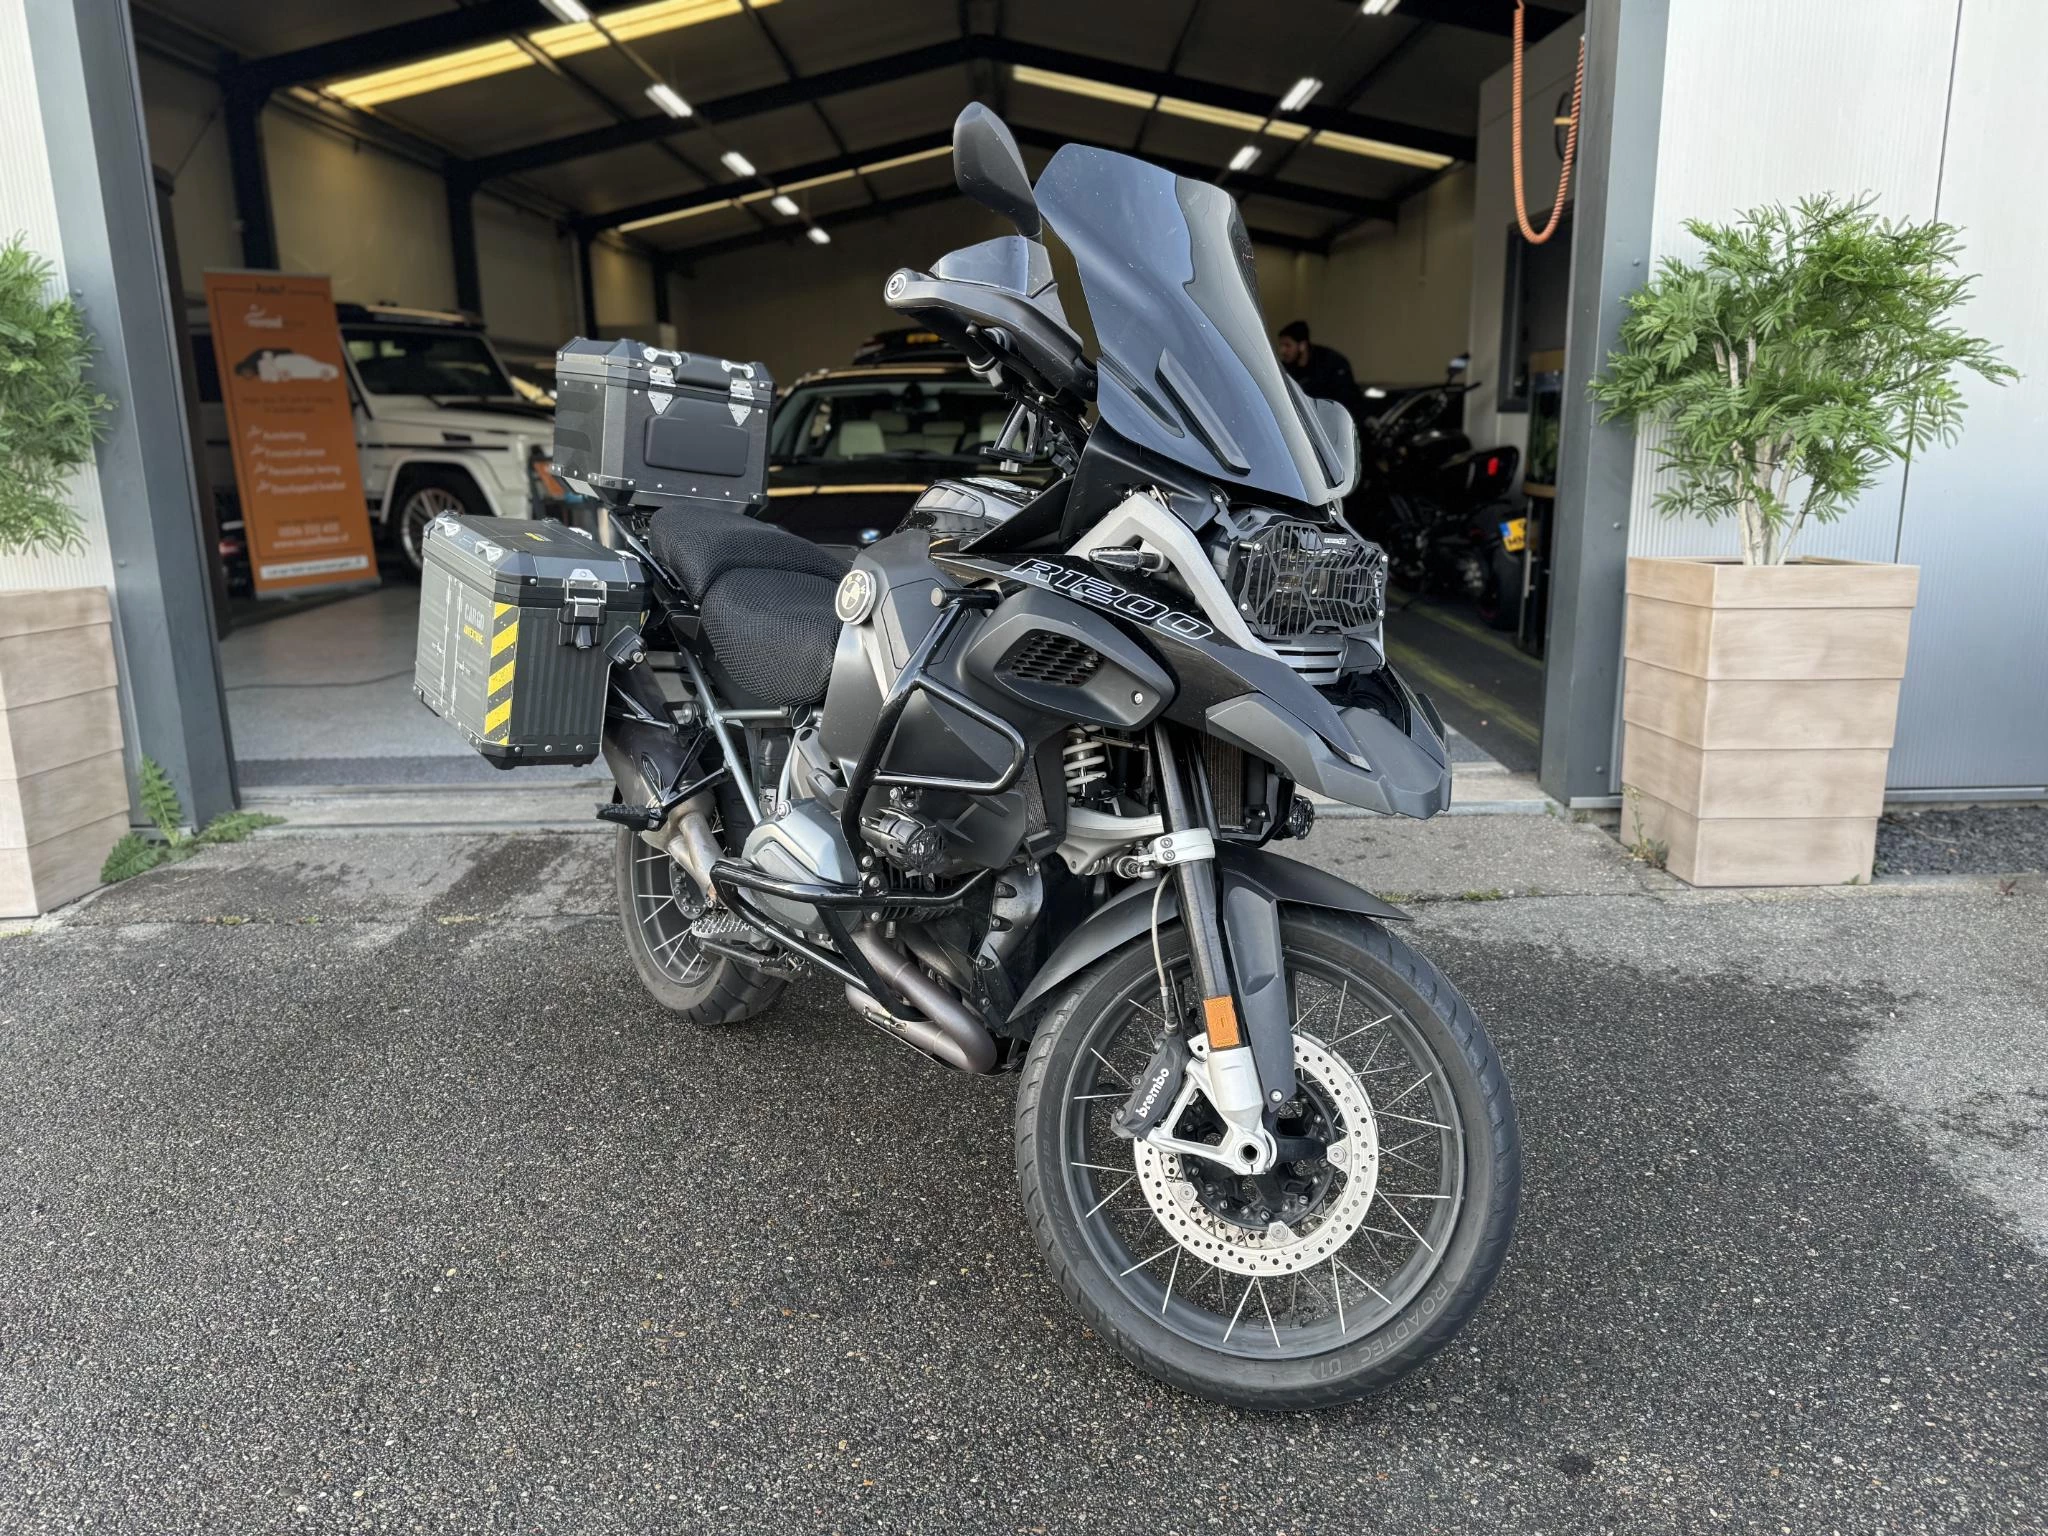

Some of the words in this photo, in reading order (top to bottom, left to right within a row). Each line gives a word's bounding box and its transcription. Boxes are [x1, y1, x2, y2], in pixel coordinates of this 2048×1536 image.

[846, 574, 866, 595] BMW
[1010, 558, 1214, 640] R1200
[464, 603, 485, 631] CARGO
[1135, 1067, 1170, 1119] brembo
[1359, 1281, 1448, 1363] ROADTEC
